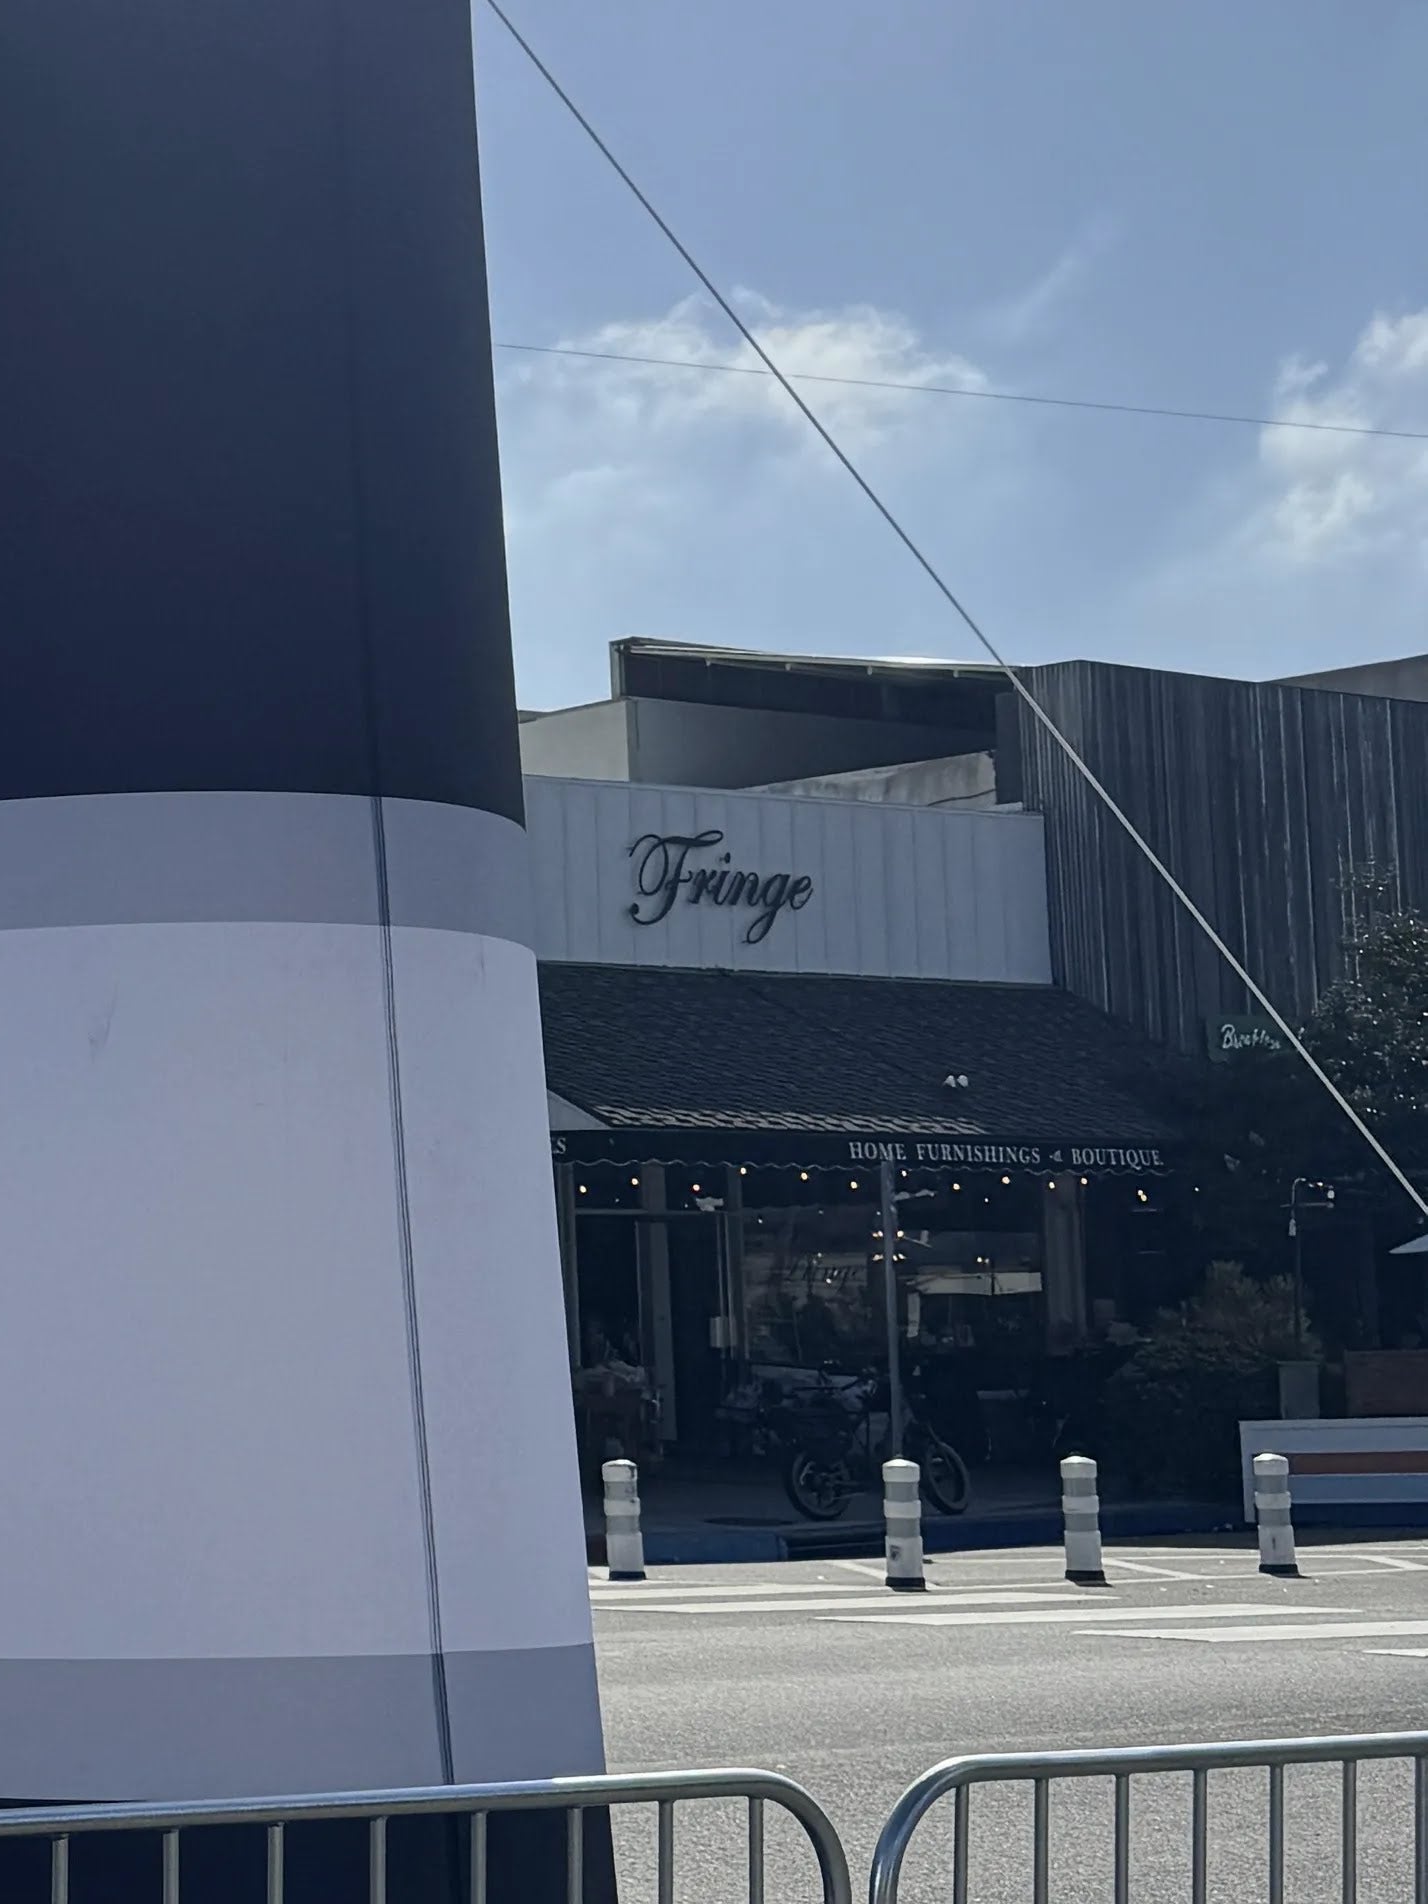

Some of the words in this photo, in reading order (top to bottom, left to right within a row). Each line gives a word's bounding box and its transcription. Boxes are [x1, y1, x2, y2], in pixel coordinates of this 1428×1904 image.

[628, 829, 815, 945] Fringe
[849, 1141, 907, 1162] HOME
[916, 1143, 1040, 1164] FURNISHINGS
